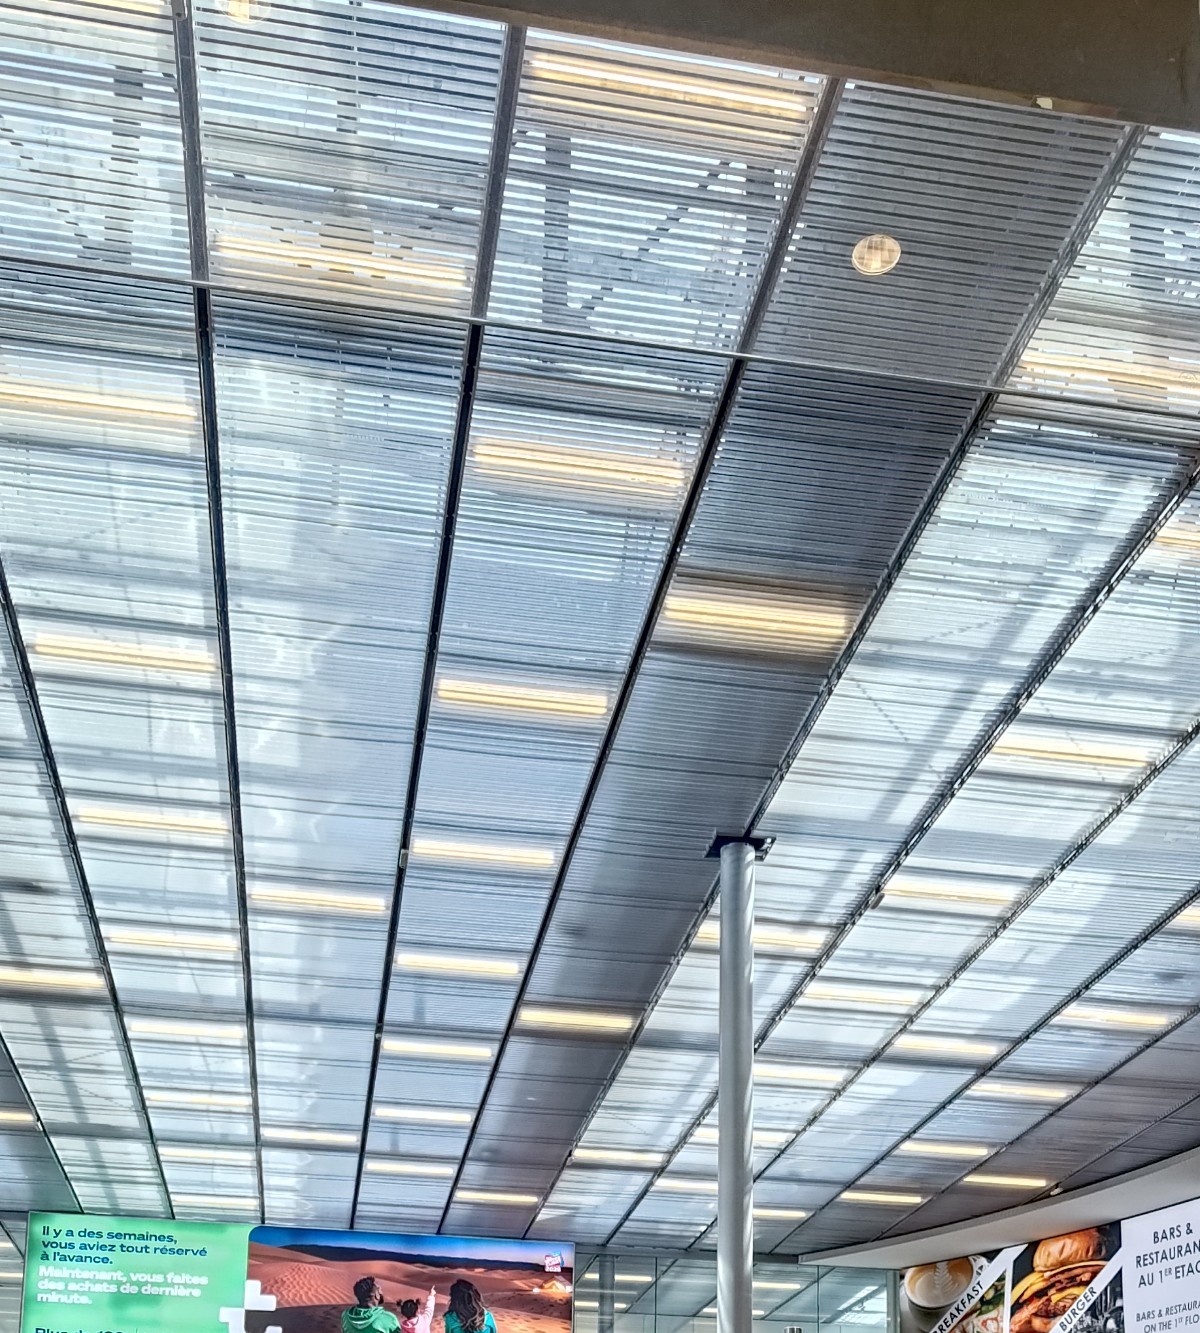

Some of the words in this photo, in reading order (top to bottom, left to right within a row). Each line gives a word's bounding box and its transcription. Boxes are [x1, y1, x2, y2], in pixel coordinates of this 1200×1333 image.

[42, 1226, 50, 1236] Il
[53, 1228, 62, 1238] y
[65, 1229, 74, 1237] a
[78, 1228, 103, 1239] des
[107, 1230, 178, 1245] semaines,
[1153, 1224, 1182, 1244] BARS
[1186, 1222, 1193, 1235] &
[42, 1240, 75, 1250] vous
[79, 1241, 116, 1252] aviez
[120, 1243, 150, 1254] tout
[153, 1245, 208, 1257] réservé
[40, 1251, 50, 1261] à
[53, 1252, 113, 1265] l'avance.
[38, 1265, 127, 1283] Maintenant,
[129, 1272, 164, 1284] vous
[166, 1271, 209, 1285] faites
[1138, 1272, 1154, 1288] AU
[37, 1279, 65, 1291] des
[67, 1280, 118, 1293] achats
[120, 1282, 139, 1294] de
[141, 1283, 202, 1298] dernière
[37, 1292, 93, 1304] minute.
[1059, 1286, 1097, 1332] BURGER
[1136, 1310, 1155, 1322] BARS
[1157, 1309, 1163, 1318] &
[1143, 1324, 1156, 1333] ON
[1158, 1320, 1172, 1331] THE
